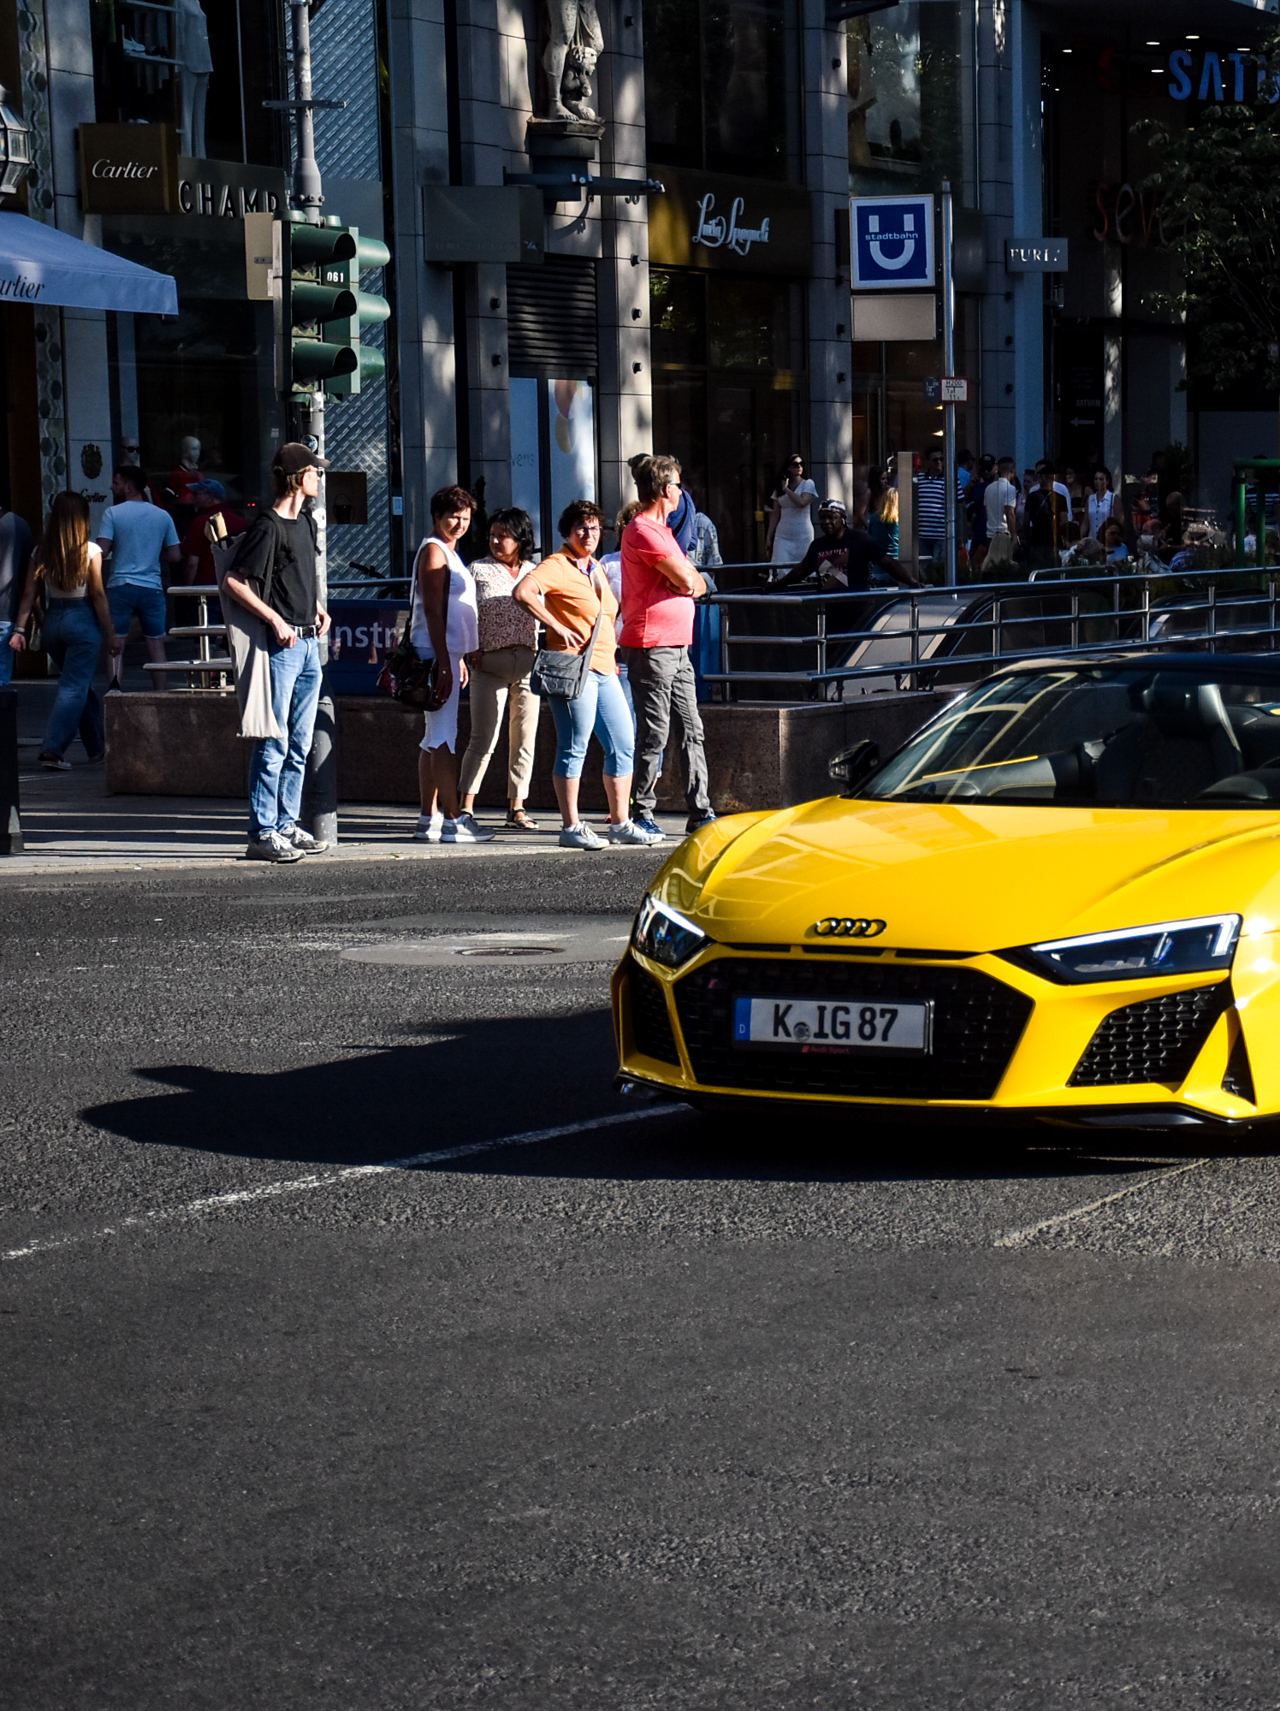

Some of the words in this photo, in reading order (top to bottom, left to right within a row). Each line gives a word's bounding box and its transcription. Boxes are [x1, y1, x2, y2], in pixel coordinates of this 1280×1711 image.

[91, 158, 158, 179] Cartier
[864, 231, 919, 241] stadtbahn
[868, 213, 915, 271] U
[326, 271, 344, 283] 061
[738, 1023, 747, 1035] D
[772, 1003, 794, 1038] K
[813, 1005, 850, 1041] IG
[858, 1006, 899, 1042] 87
